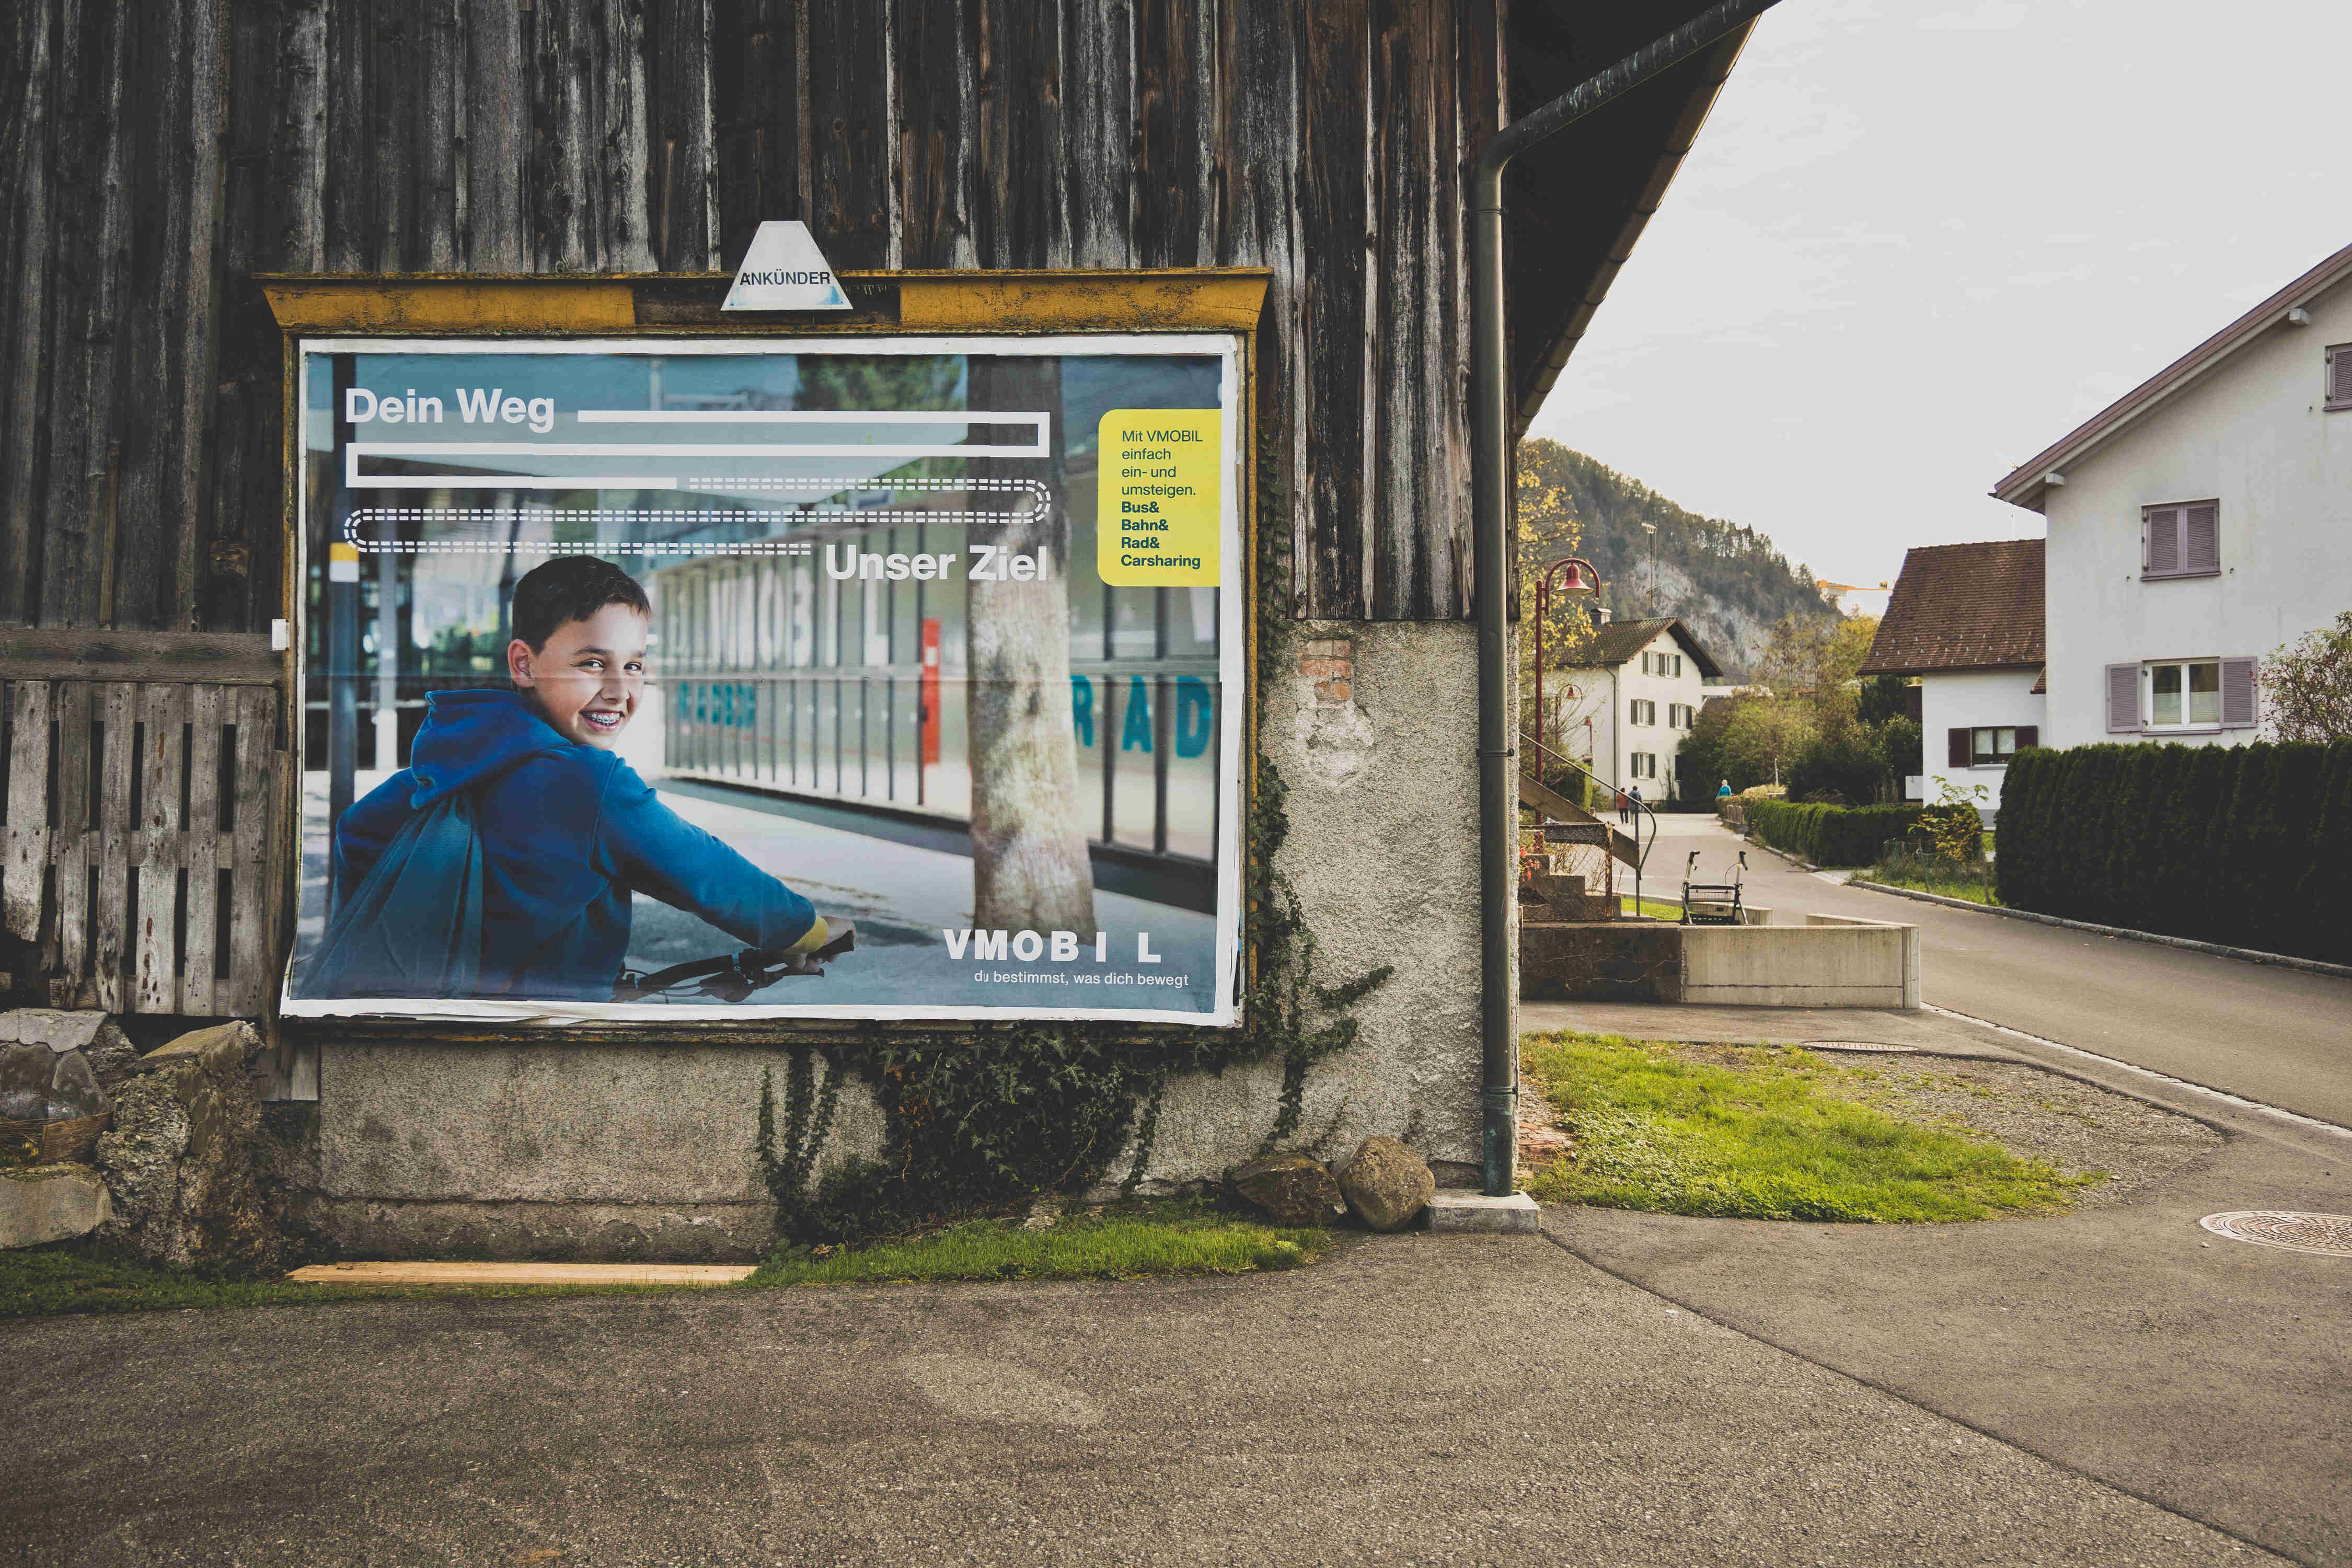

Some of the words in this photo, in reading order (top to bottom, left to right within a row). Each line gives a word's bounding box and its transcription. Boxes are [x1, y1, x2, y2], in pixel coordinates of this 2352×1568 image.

[740, 268, 831, 285] ANKÜNDER
[345, 388, 443, 423] Dein
[455, 388, 555, 433] Weg
[1122, 430, 1144, 442] Mit
[1146, 430, 1203, 442] VMOBIL
[1121, 448, 1171, 460] einfach
[1121, 466, 1147, 478] ein-
[1150, 466, 1177, 478] und
[1121, 484, 1196, 498] umsteigen.
[1121, 501, 1160, 513] Bus&
[1121, 518, 1169, 531] Bahn&
[1121, 536, 1160, 549] Rad&
[825, 544, 956, 581] Unser
[969, 545, 1047, 581] Ziel
[1121, 555, 1201, 569] Carsharing
[1070, 674, 1212, 758] RAD
[974, 970, 989, 983] du
[993, 971, 1069, 986] bestimmst,
[1073, 974, 1100, 984] was
[1104, 972, 1134, 985] dich
[1137, 973, 1189, 988] bewegt
